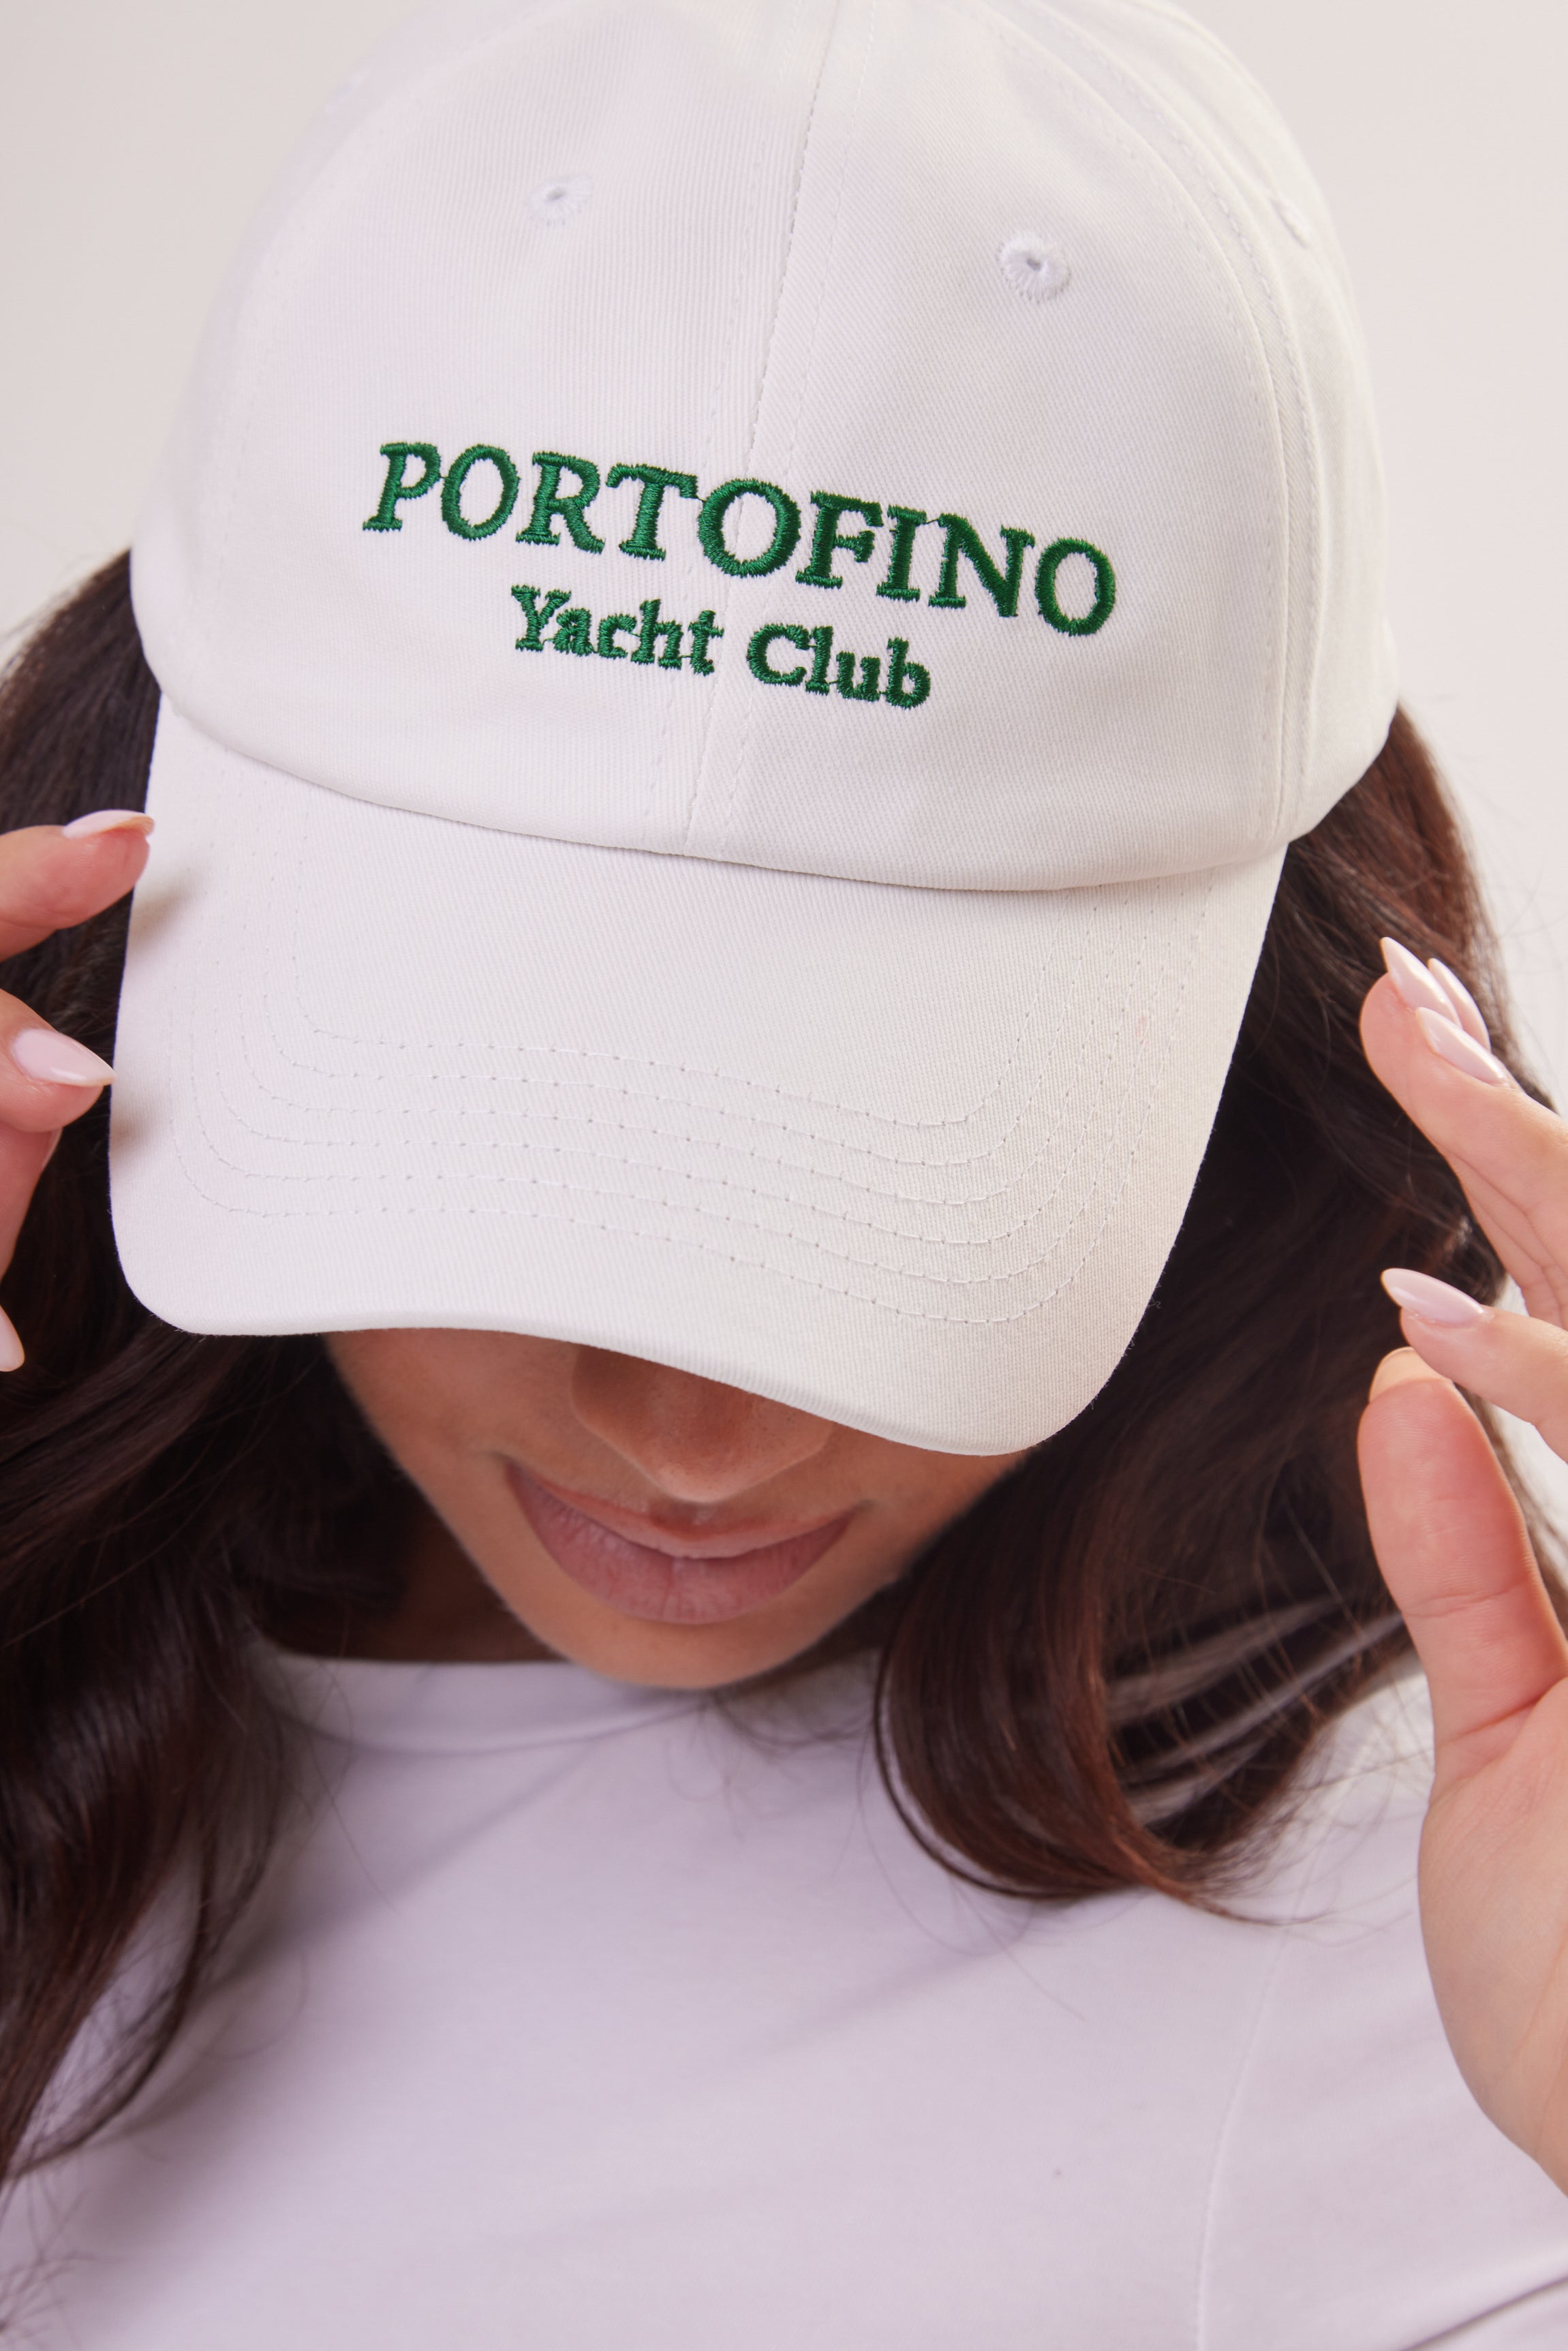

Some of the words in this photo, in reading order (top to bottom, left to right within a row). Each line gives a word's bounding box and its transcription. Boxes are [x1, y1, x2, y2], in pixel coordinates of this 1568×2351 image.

[363, 442, 1116, 636] PORTOFINO
[512, 585, 724, 676] Yacht
[748, 624, 930, 709] Club
